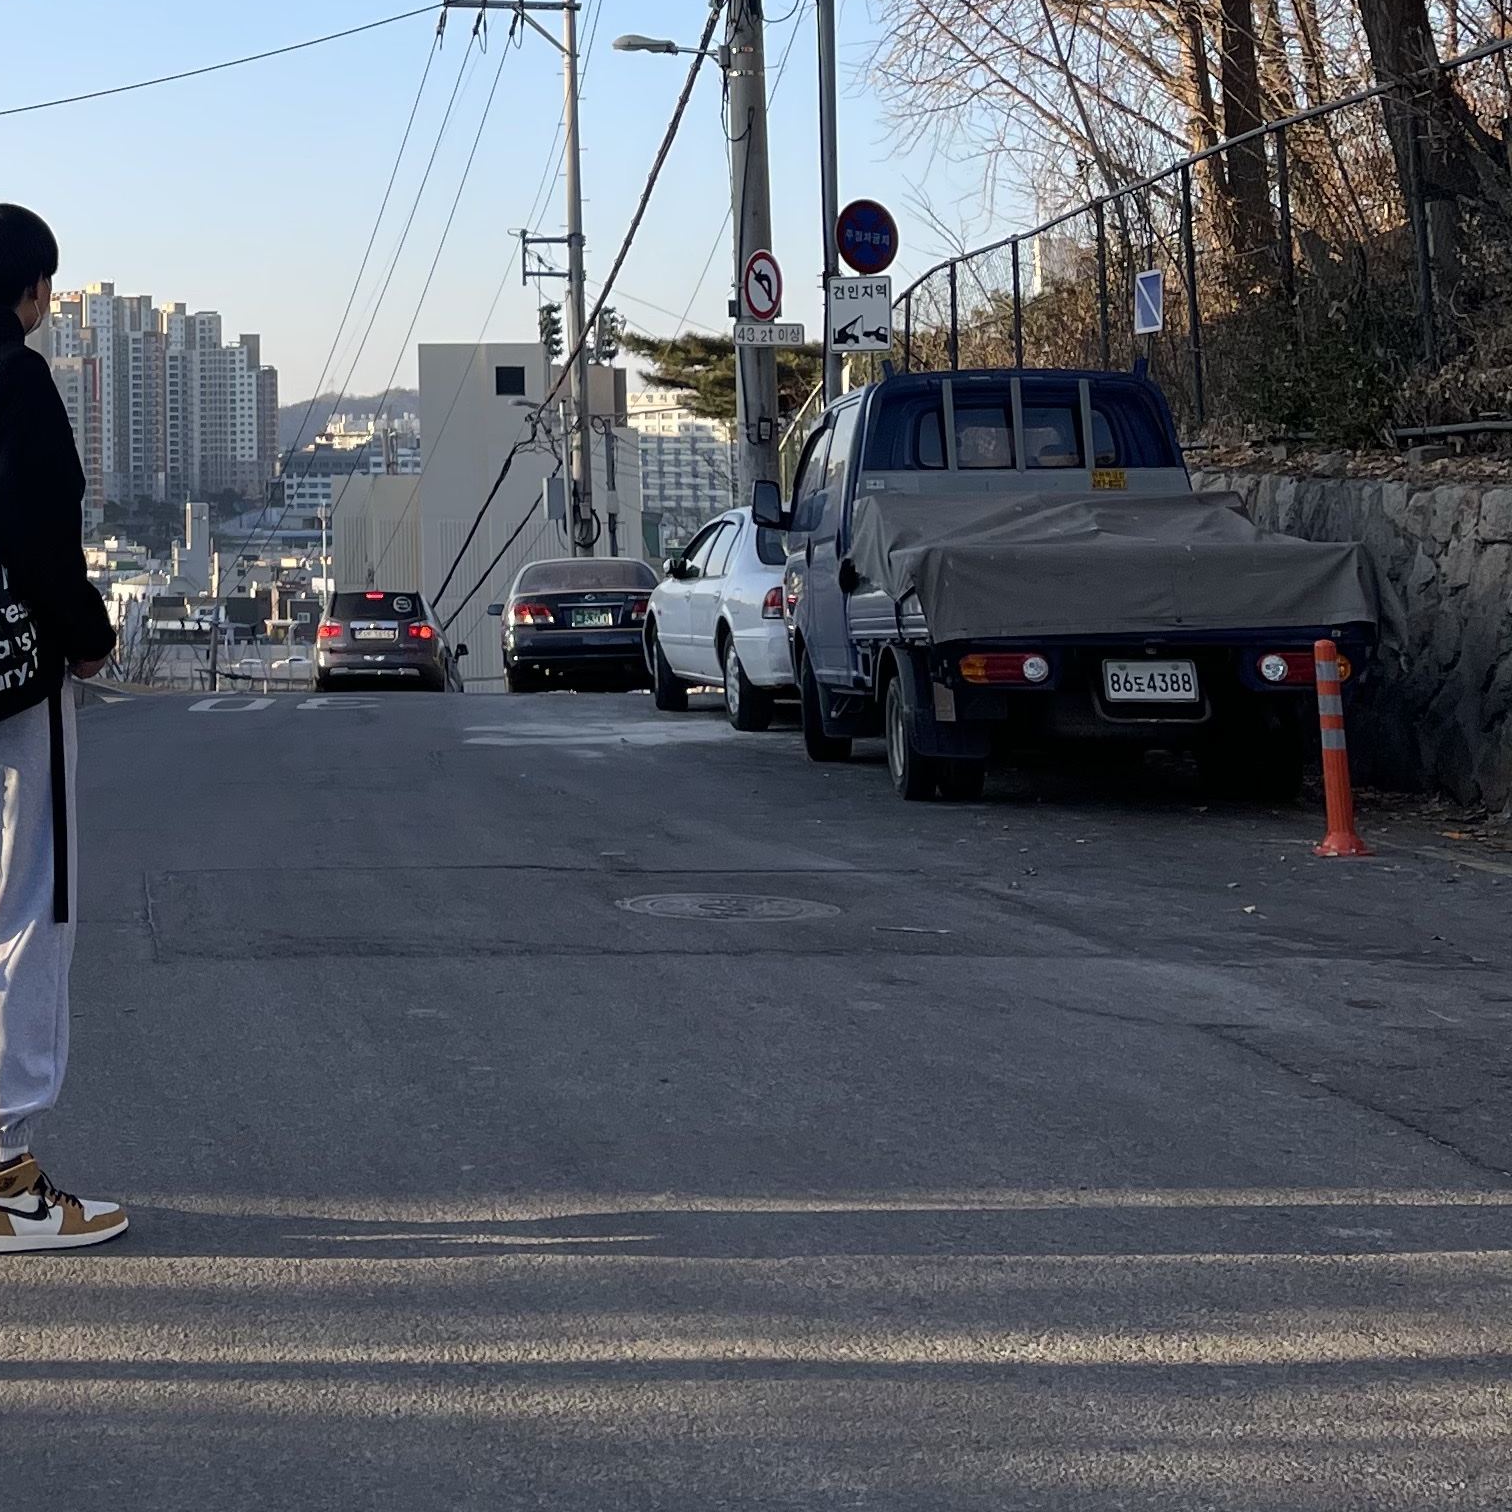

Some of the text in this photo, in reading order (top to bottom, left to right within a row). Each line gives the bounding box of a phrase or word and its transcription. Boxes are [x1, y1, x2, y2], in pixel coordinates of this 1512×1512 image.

[833, 283, 887, 300] 견인지역
[738, 327, 800, 343] 43.2t 이상
[1110, 672, 1192, 694] 86도4388
